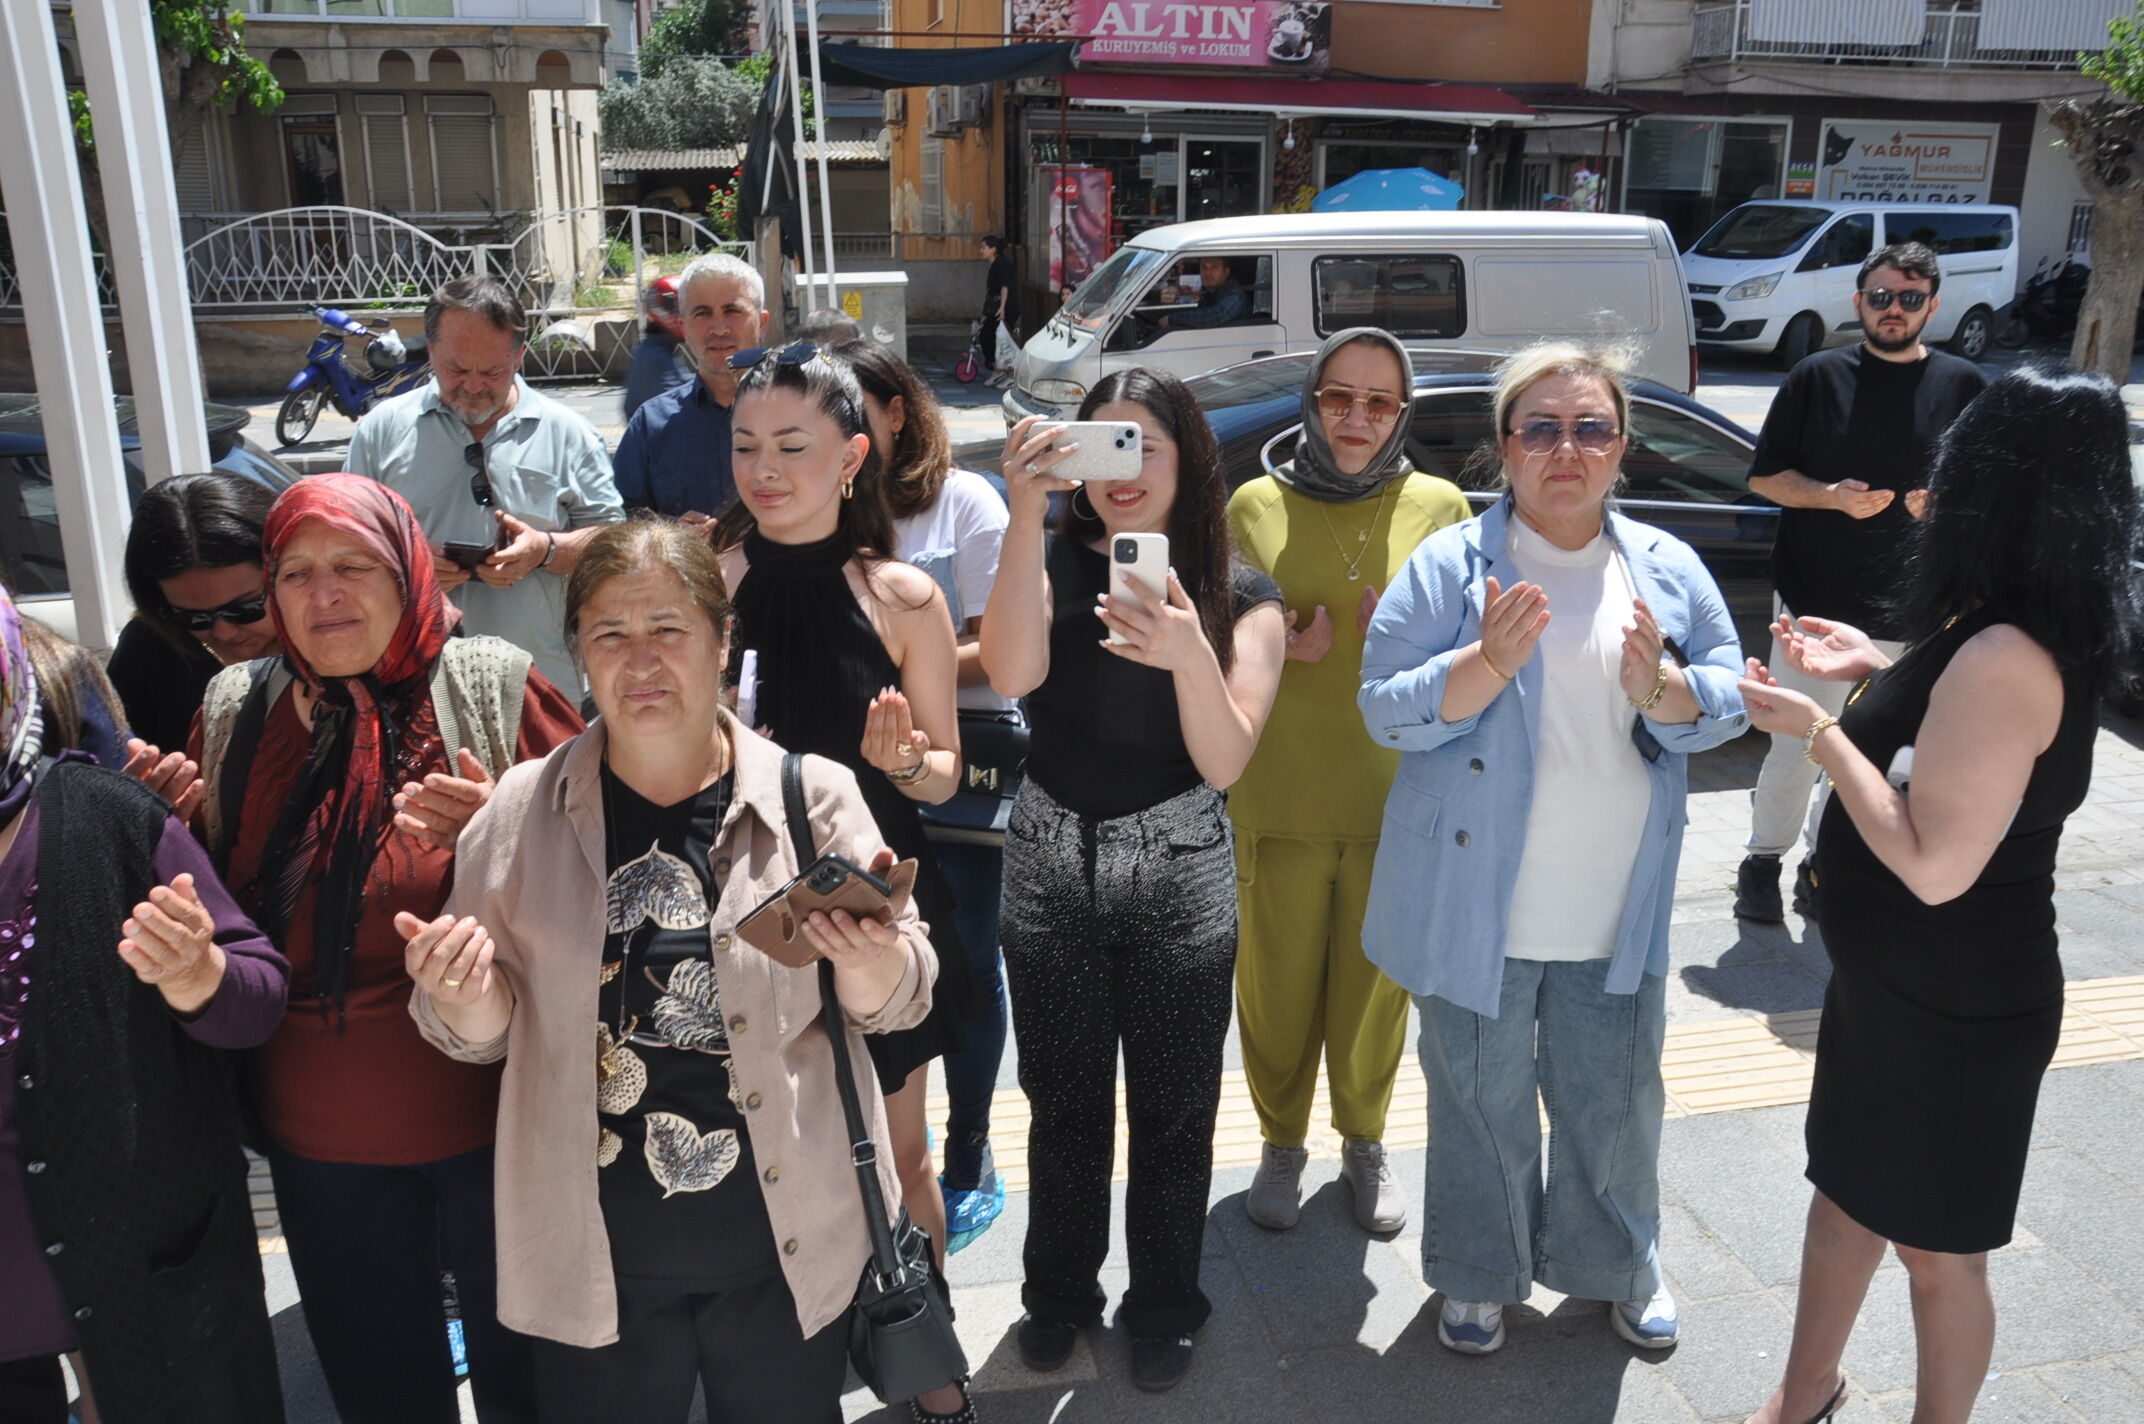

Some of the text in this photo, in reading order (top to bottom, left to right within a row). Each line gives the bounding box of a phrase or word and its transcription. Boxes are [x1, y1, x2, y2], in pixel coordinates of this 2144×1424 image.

[1091, 2, 1255, 39] ALTIN
[1092, 41, 1251, 58] KURUYEMİŞ ve LOKUM
[1861, 143, 1951, 159] YAĞMUR
